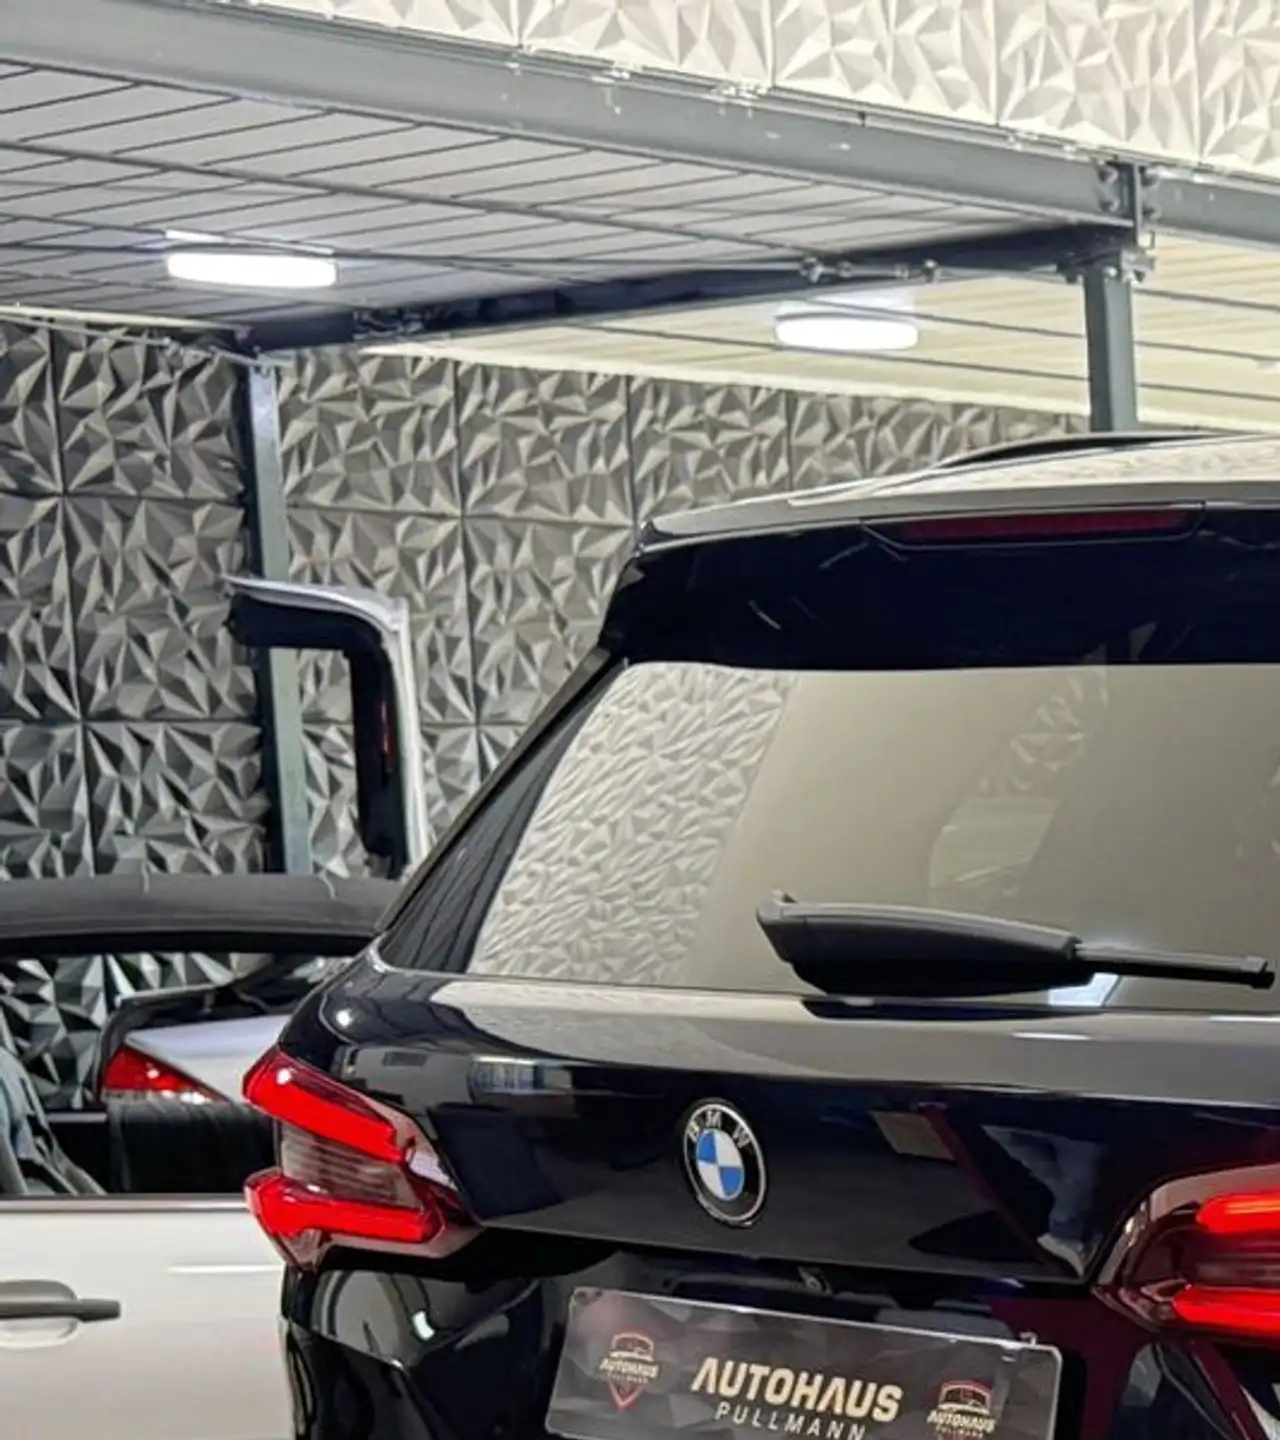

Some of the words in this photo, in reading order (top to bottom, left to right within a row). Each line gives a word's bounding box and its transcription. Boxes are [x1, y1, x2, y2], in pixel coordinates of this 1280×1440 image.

[688, 1110, 750, 1148] BMW
[691, 1357, 904, 1422] AUTOHAUS
[926, 1409, 996, 1434] AUTOHAUS
